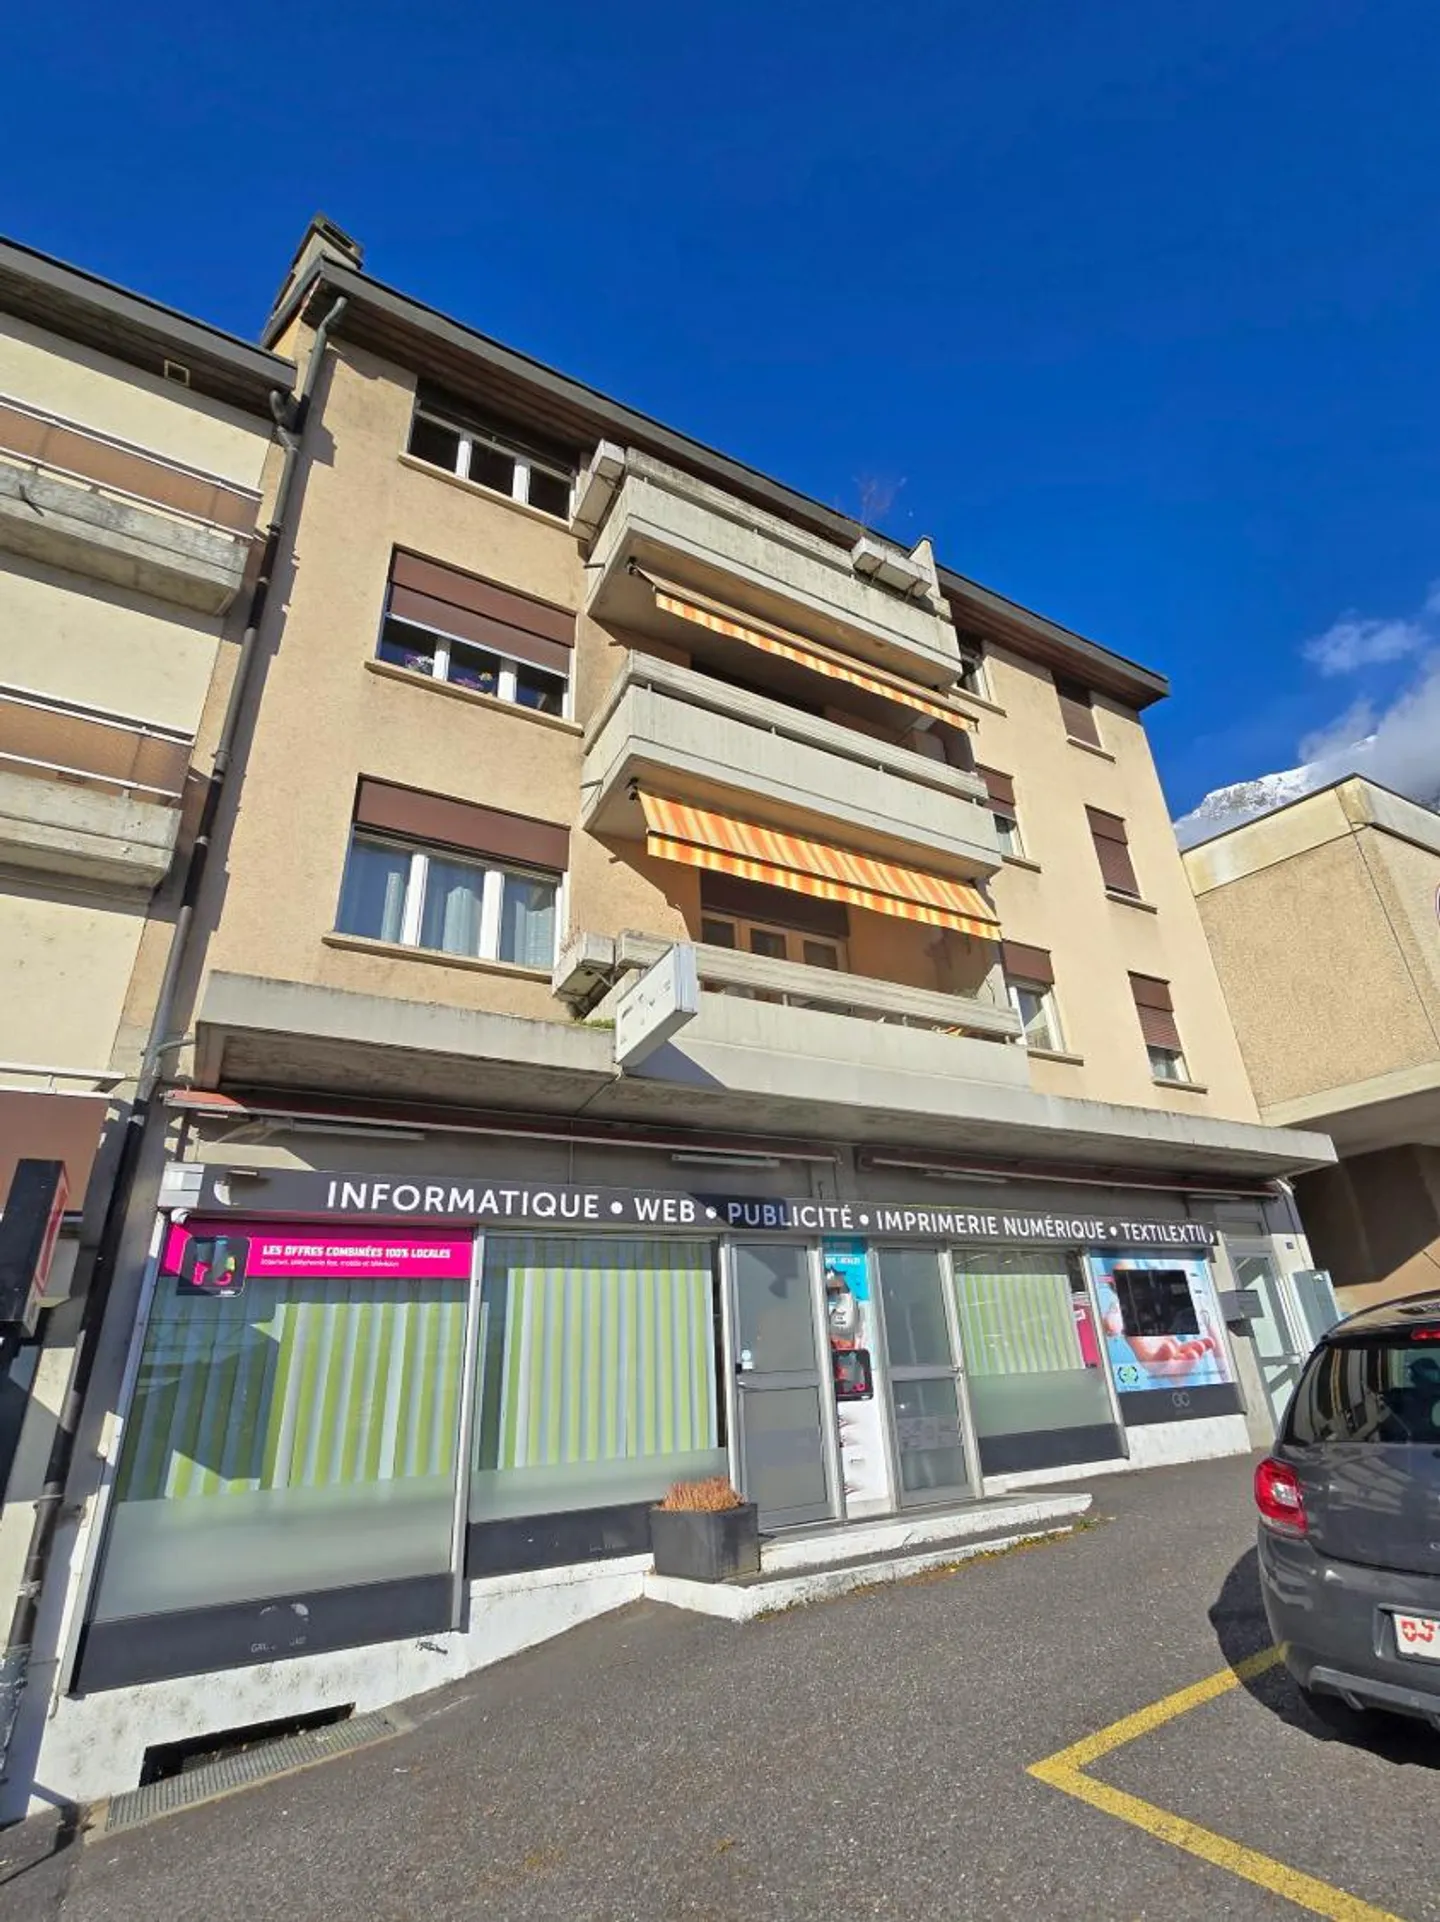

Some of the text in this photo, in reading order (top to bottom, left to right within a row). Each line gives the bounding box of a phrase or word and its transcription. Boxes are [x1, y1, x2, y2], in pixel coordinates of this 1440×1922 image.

[327, 1180, 600, 1219] INFORMATIQUE
[634, 1197, 696, 1223] WEB
[727, 1202, 854, 1229] PUBLICITÉ
[876, 1210, 999, 1235] IMPRIMERIE
[1003, 1214, 1107, 1239] NUMÉRIQUE
[261, 1245, 451, 1260] LES OFFRES COMBINÉES 100% LOCALES
